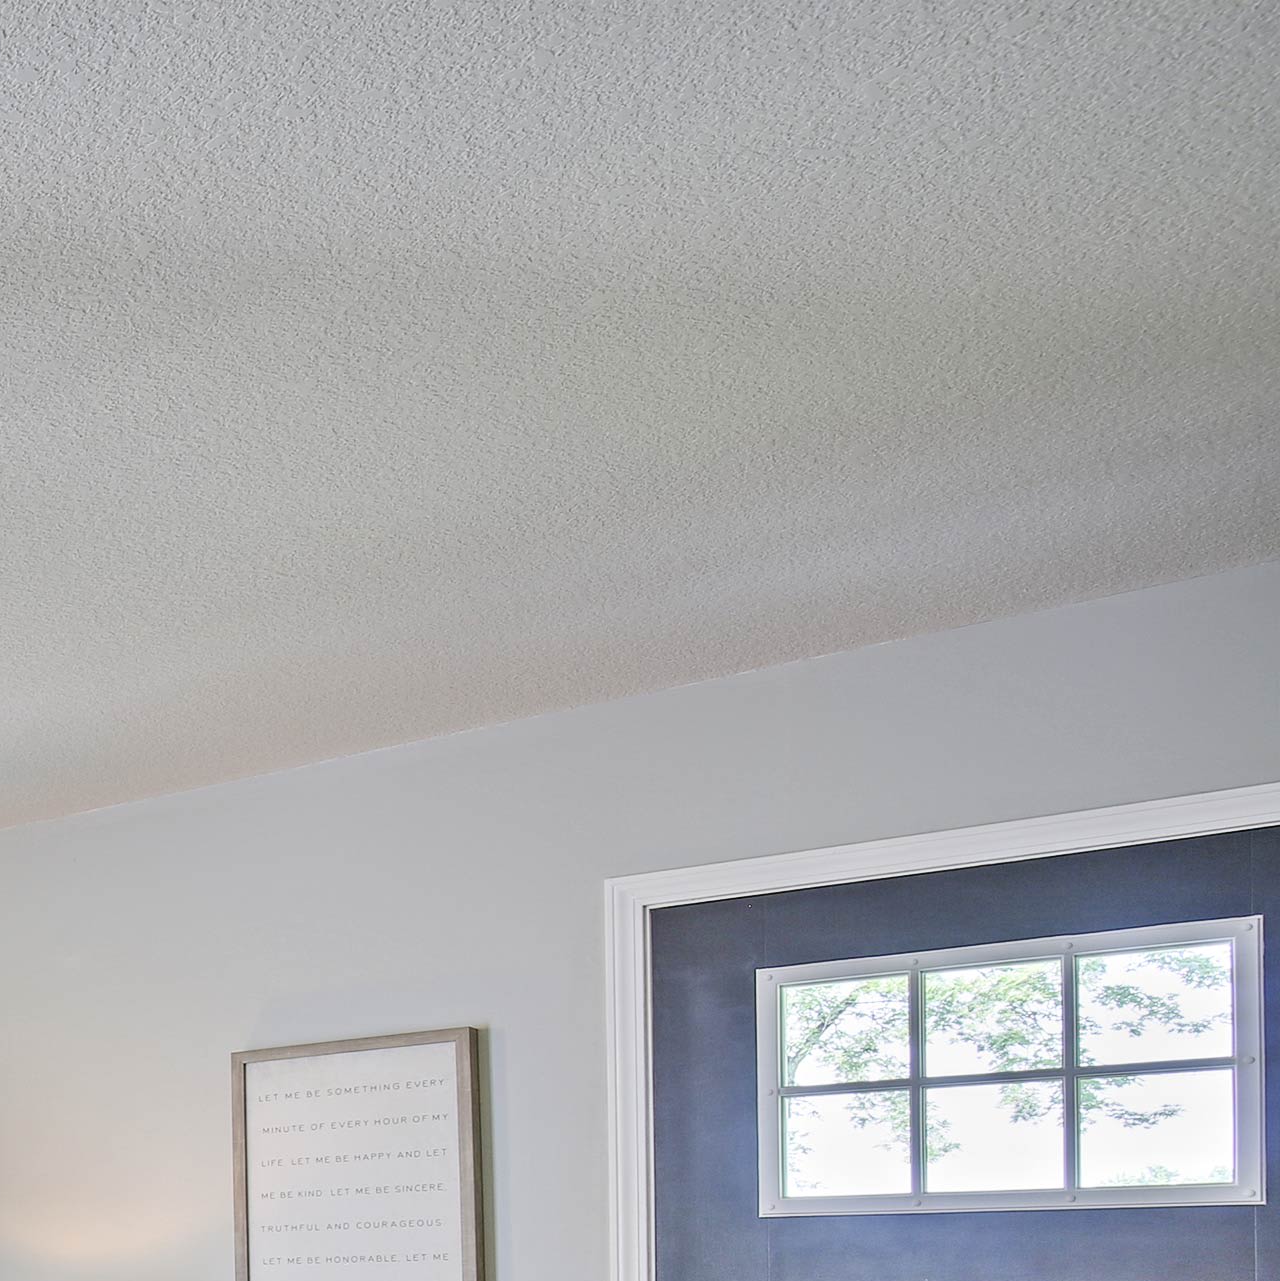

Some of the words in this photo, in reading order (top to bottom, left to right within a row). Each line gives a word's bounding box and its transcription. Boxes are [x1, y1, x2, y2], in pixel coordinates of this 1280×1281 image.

[258, 1093, 279, 1103] LET
[284, 1091, 300, 1100] ME
[306, 1089, 321, 1098] BE
[327, 1081, 401, 1096] SOMETHING
[405, 1078, 445, 1090] EVERY
[261, 1124, 305, 1135] MINUTE
[310, 1122, 326, 1131] OF
[330, 1119, 370, 1130] EVERY
[374, 1116, 408, 1126] HOUR
[412, 1114, 428, 1124] OF
[431, 1113, 449, 1121] MY
[291, 1157, 311, 1166] LET
[315, 1156, 330, 1164] ME
[335, 1154, 350, 1163] BE
[354, 1152, 392, 1161] HAPPY
[397, 1150, 421, 1159] AND
[425, 1148, 448, 1158] LET
[261, 1191, 275, 1200] ME
[279, 1190, 293, 1199] BE
[330, 1187, 350, 1197] LET
[355, 1186, 371, 1195] ME
[375, 1185, 390, 1194] BE
[326, 1222, 350, 1231] AND
[262, 1257, 282, 1266] LET
[287, 1256, 302, 1265] ME
[307, 1256, 321, 1265] BE
[405, 1253, 427, 1262] LET
[432, 1253, 449, 1261] ME
